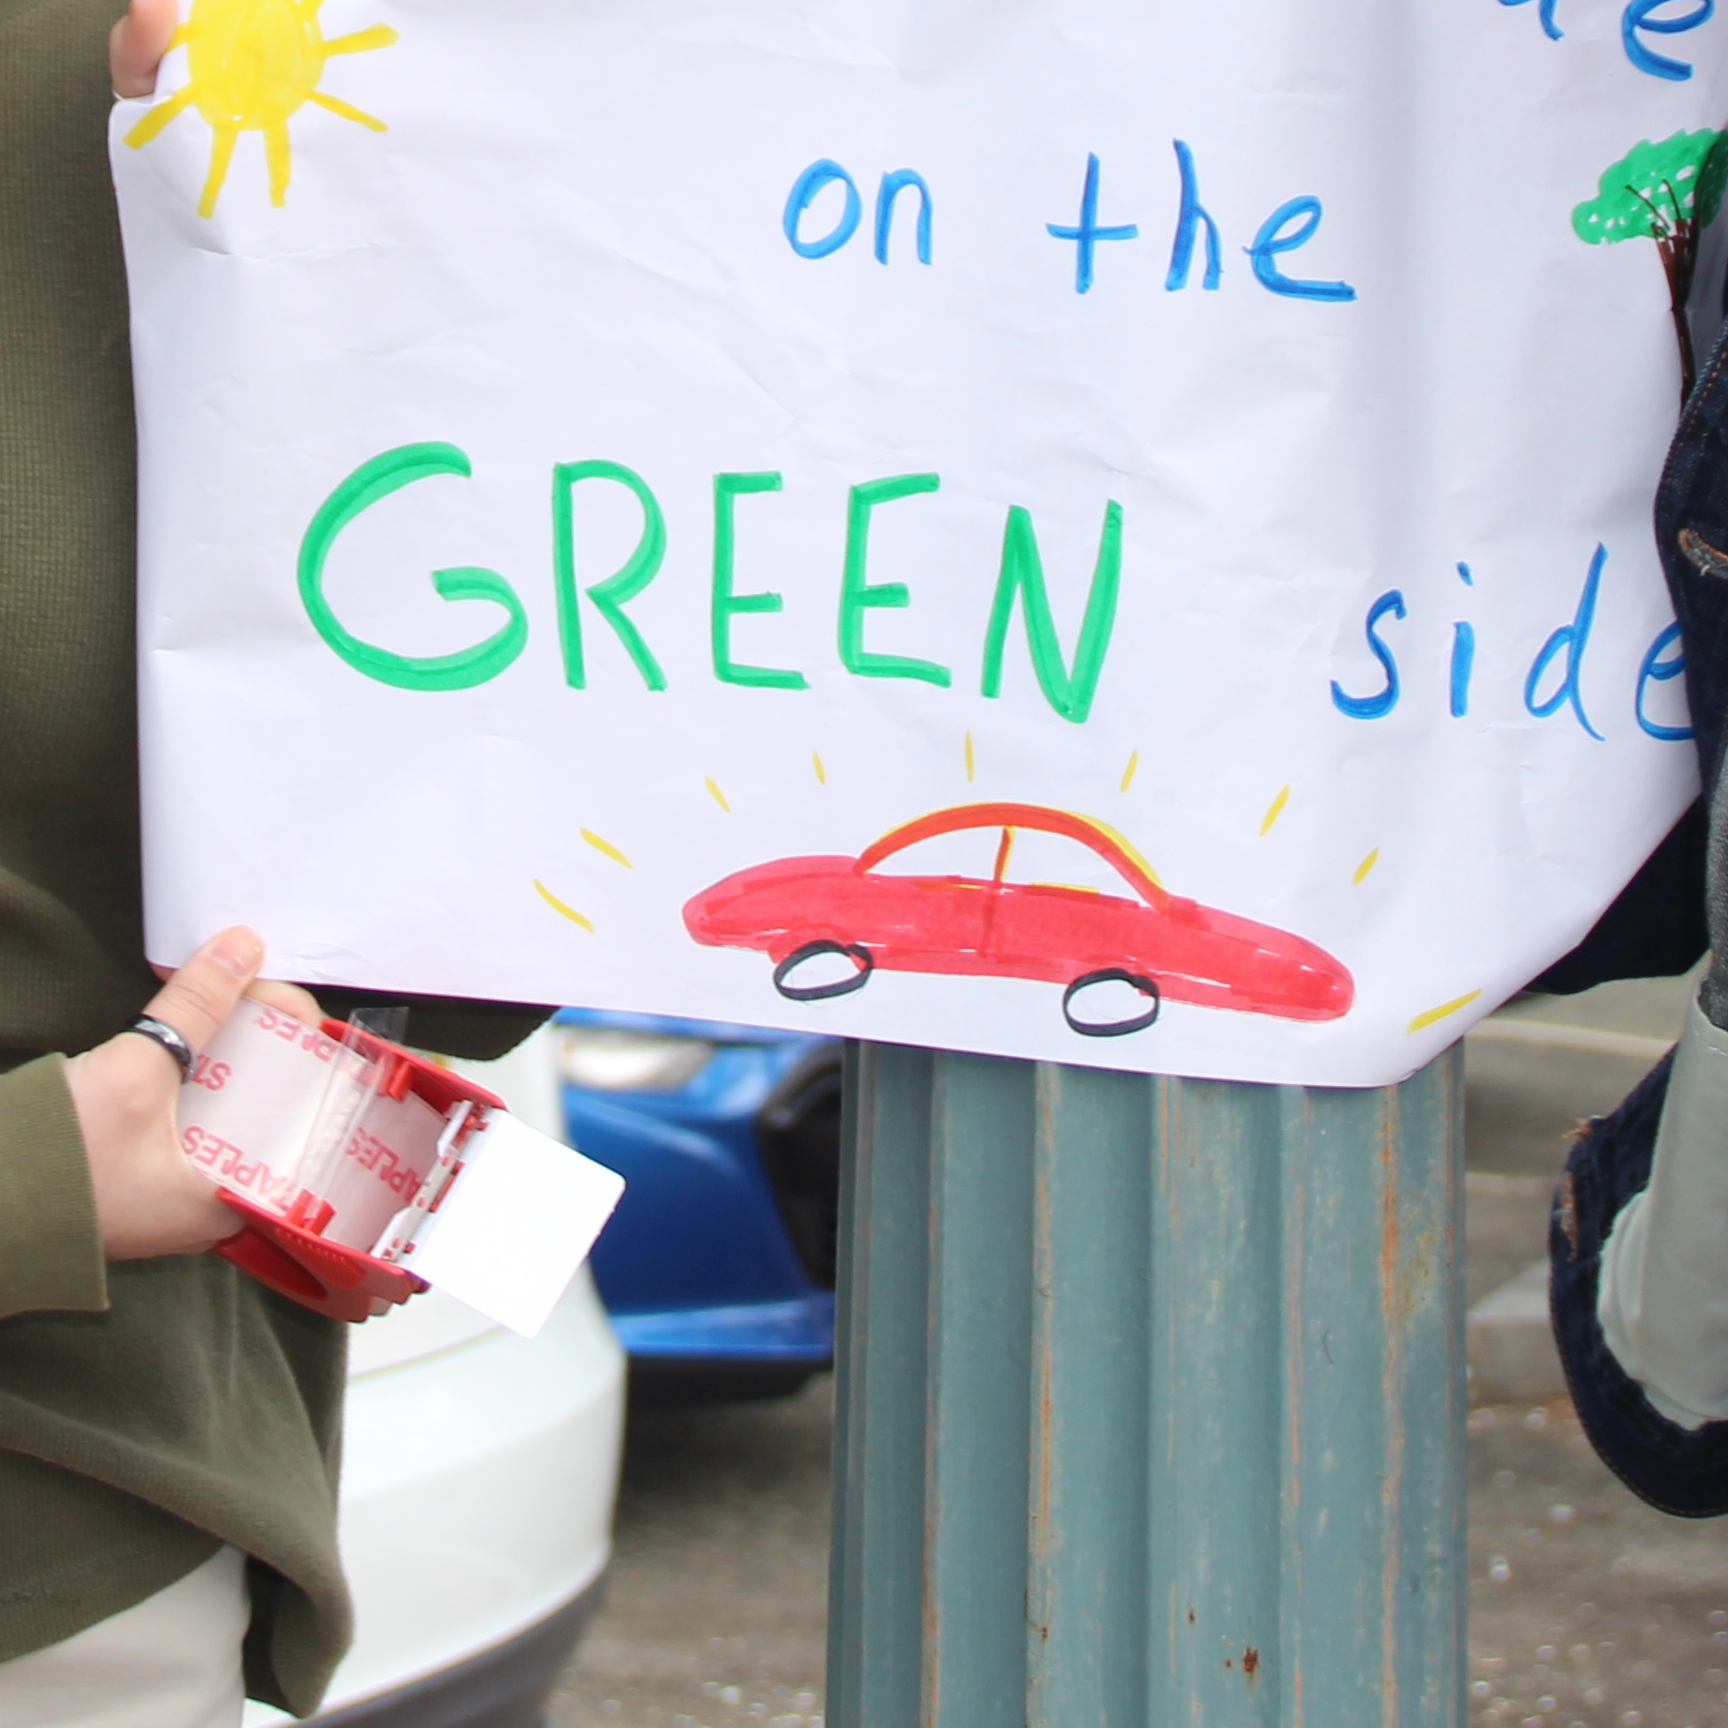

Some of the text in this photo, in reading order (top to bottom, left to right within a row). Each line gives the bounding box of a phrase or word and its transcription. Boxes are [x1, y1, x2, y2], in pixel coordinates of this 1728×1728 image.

[783, 139, 1358, 303] on the
[297, 441, 1696, 742] GREEN side
